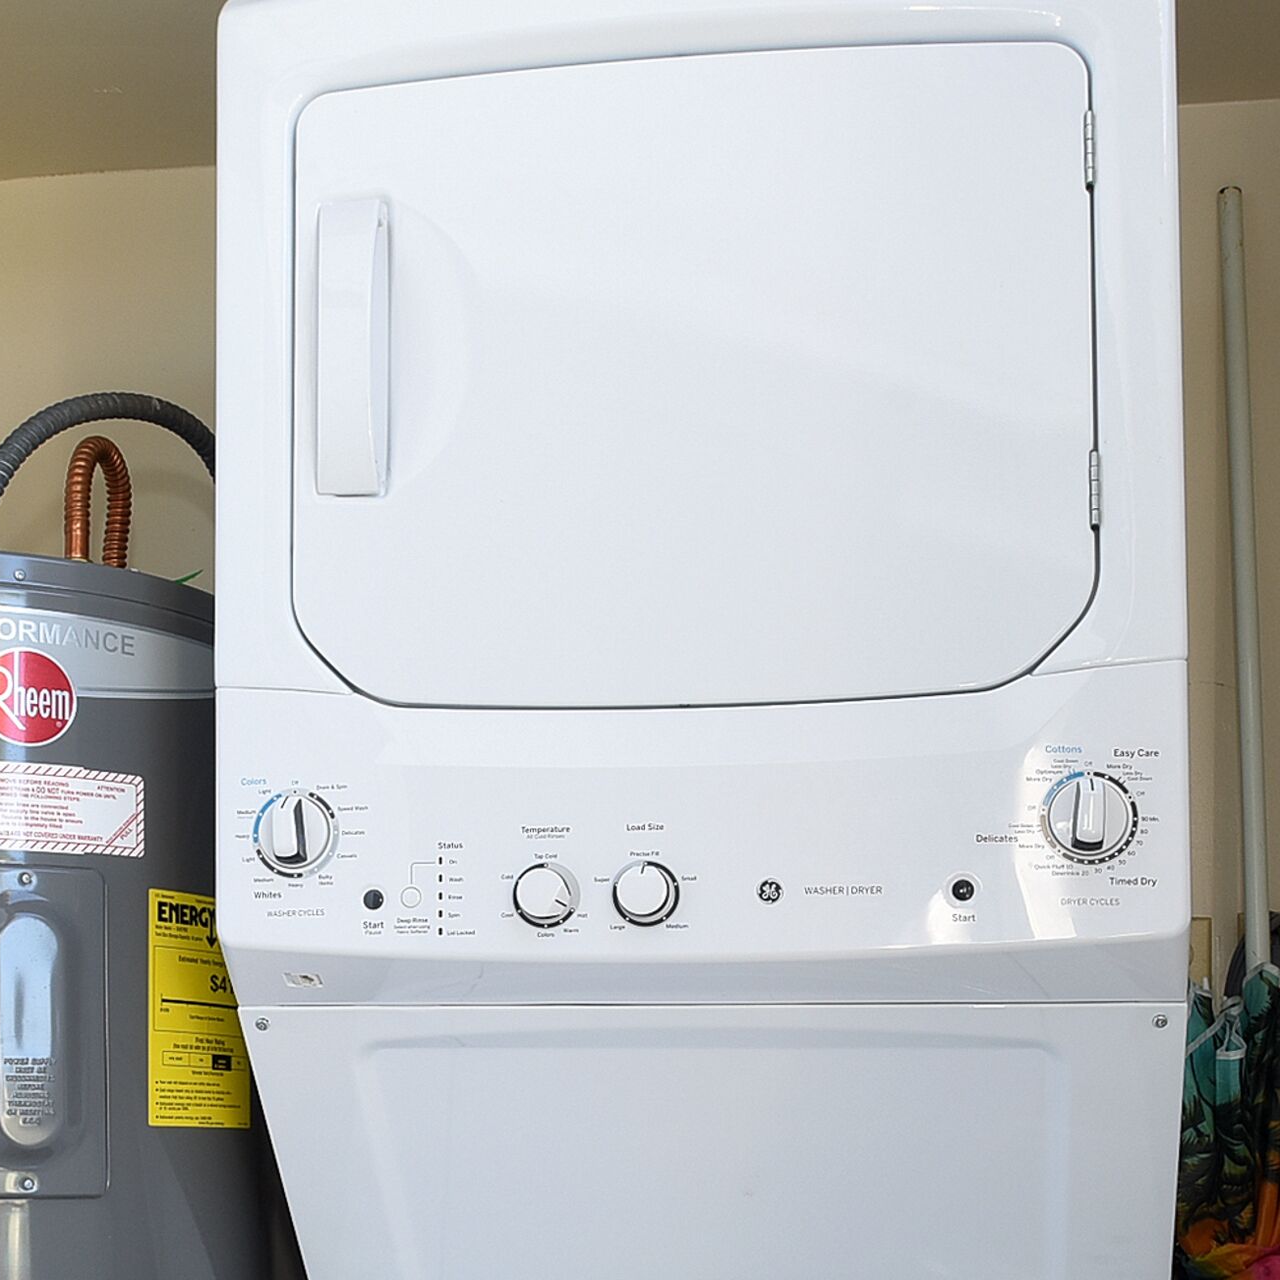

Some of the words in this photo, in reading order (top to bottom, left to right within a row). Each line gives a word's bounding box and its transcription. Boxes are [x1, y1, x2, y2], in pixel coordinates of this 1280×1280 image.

[1045, 745, 1082, 753] Cottons
[1113, 749, 1135, 758] Easy
[1137, 749, 1160, 757] Care
[240, 778, 267, 786] Colors
[521, 826, 571, 834] Temperature
[626, 824, 646, 832] Load
[648, 823, 664, 831] Size
[976, 834, 1018, 843] Delicates
[1109, 878, 1138, 886] Timed
[1141, 878, 1157, 886] Dry
[804, 886, 845, 896] WASHER
[850, 886, 883, 895] DRYER
[1061, 898, 1087, 906] DRYER
[1090, 898, 1120, 906] CYCLES
[952, 913, 976, 922] Start
[363, 921, 384, 929] Start
